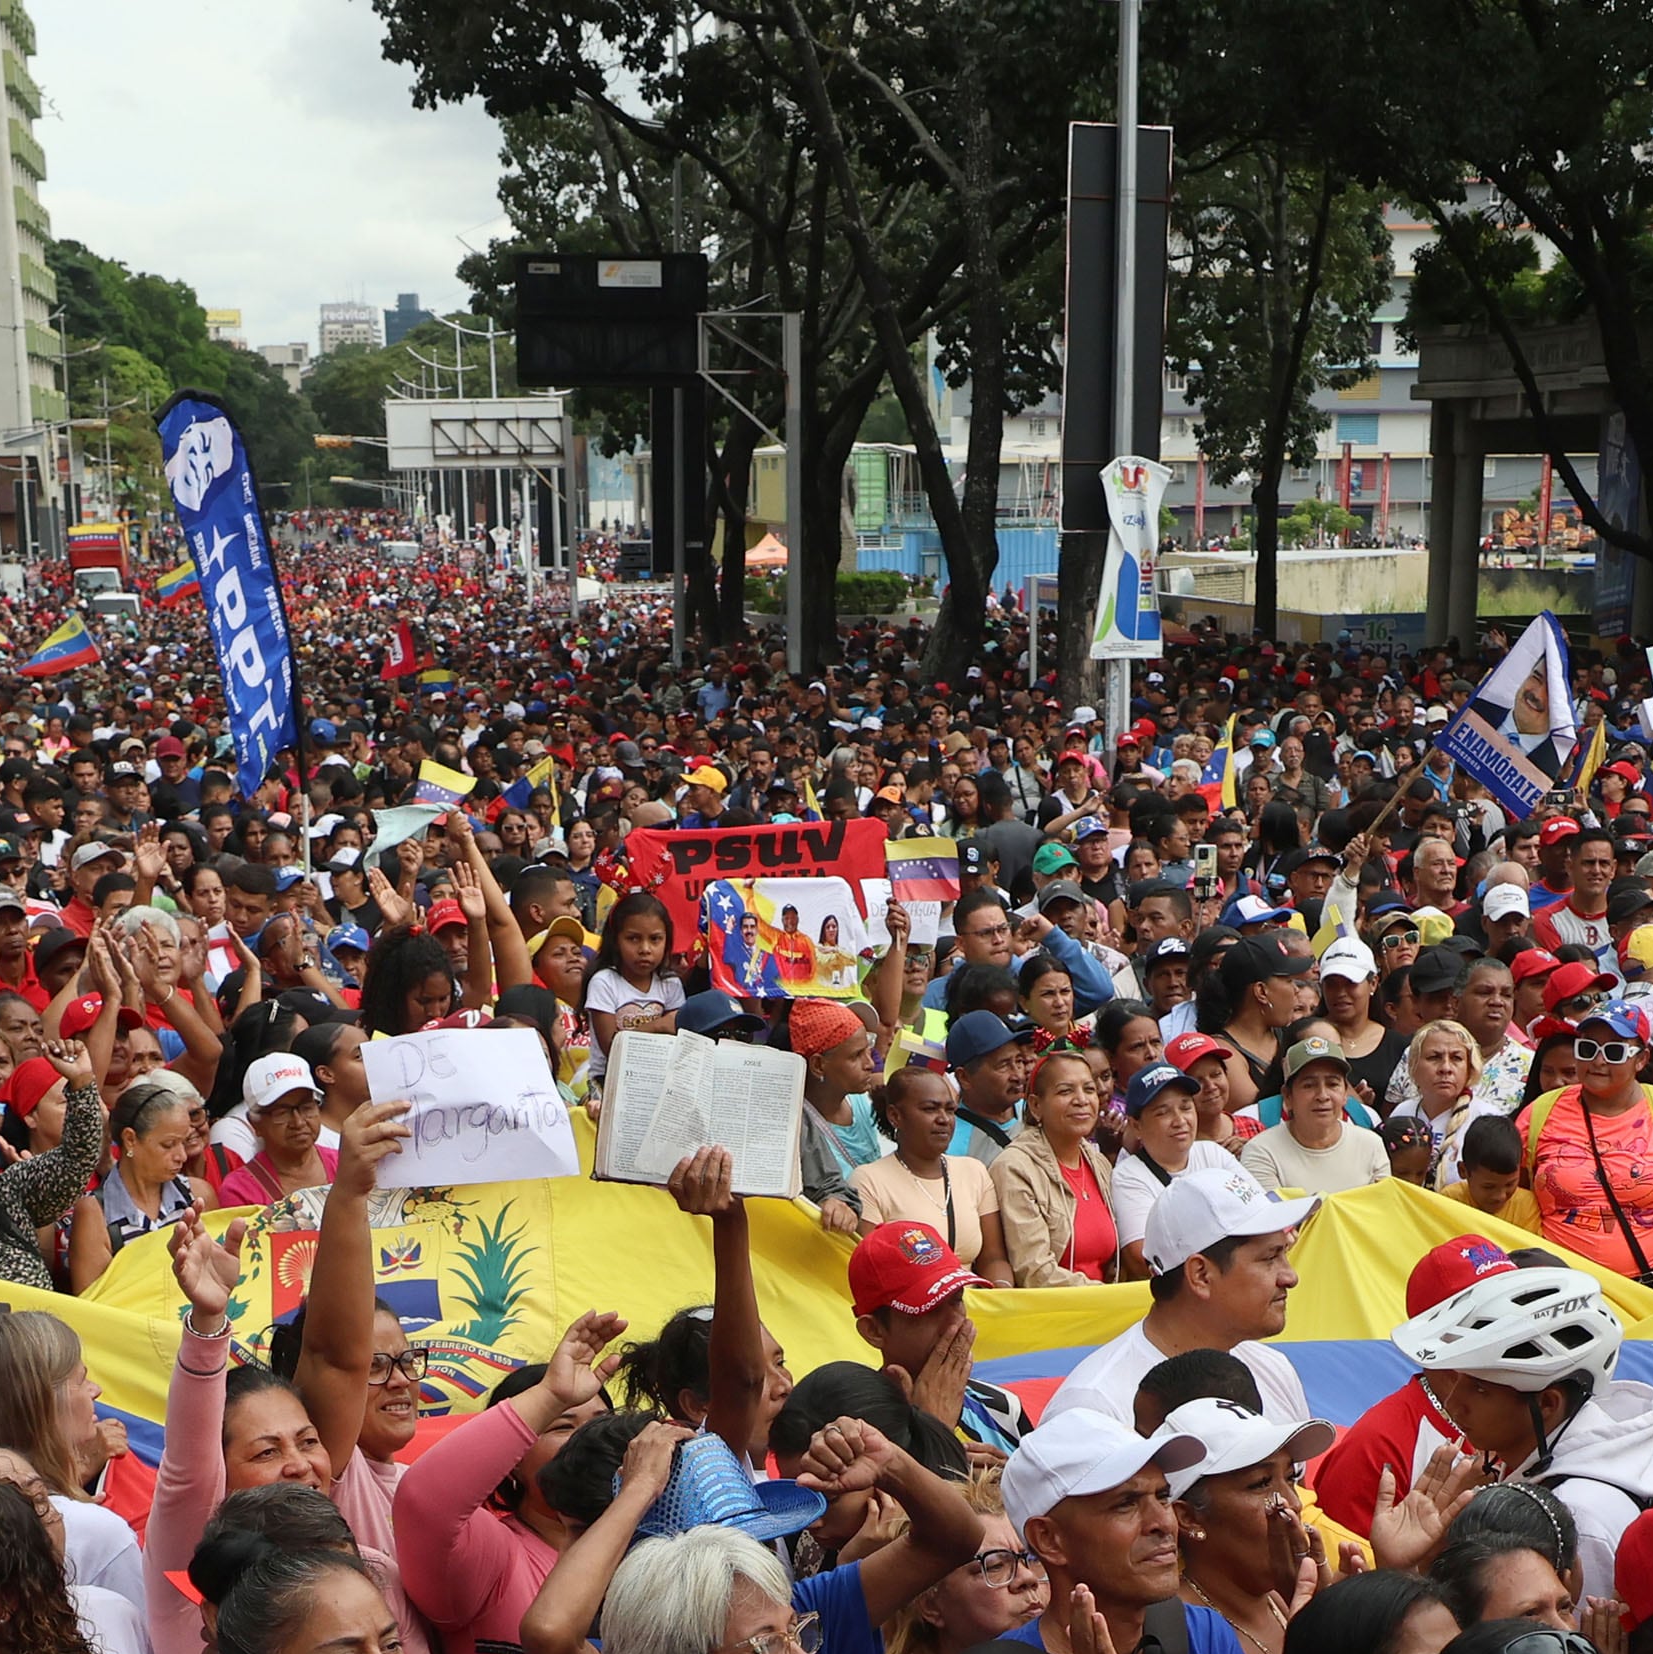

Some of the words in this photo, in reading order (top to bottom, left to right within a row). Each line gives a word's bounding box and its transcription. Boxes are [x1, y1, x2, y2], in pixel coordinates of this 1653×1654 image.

[213, 565, 284, 735] PPT
[1452, 720, 1545, 811] ENAMÓRATE
[667, 822, 846, 877] PSUV
[1549, 1294, 1598, 1319] FOX
[429, 1341, 478, 1353] FEBRERO
[478, 1349, 492, 1360] DE
